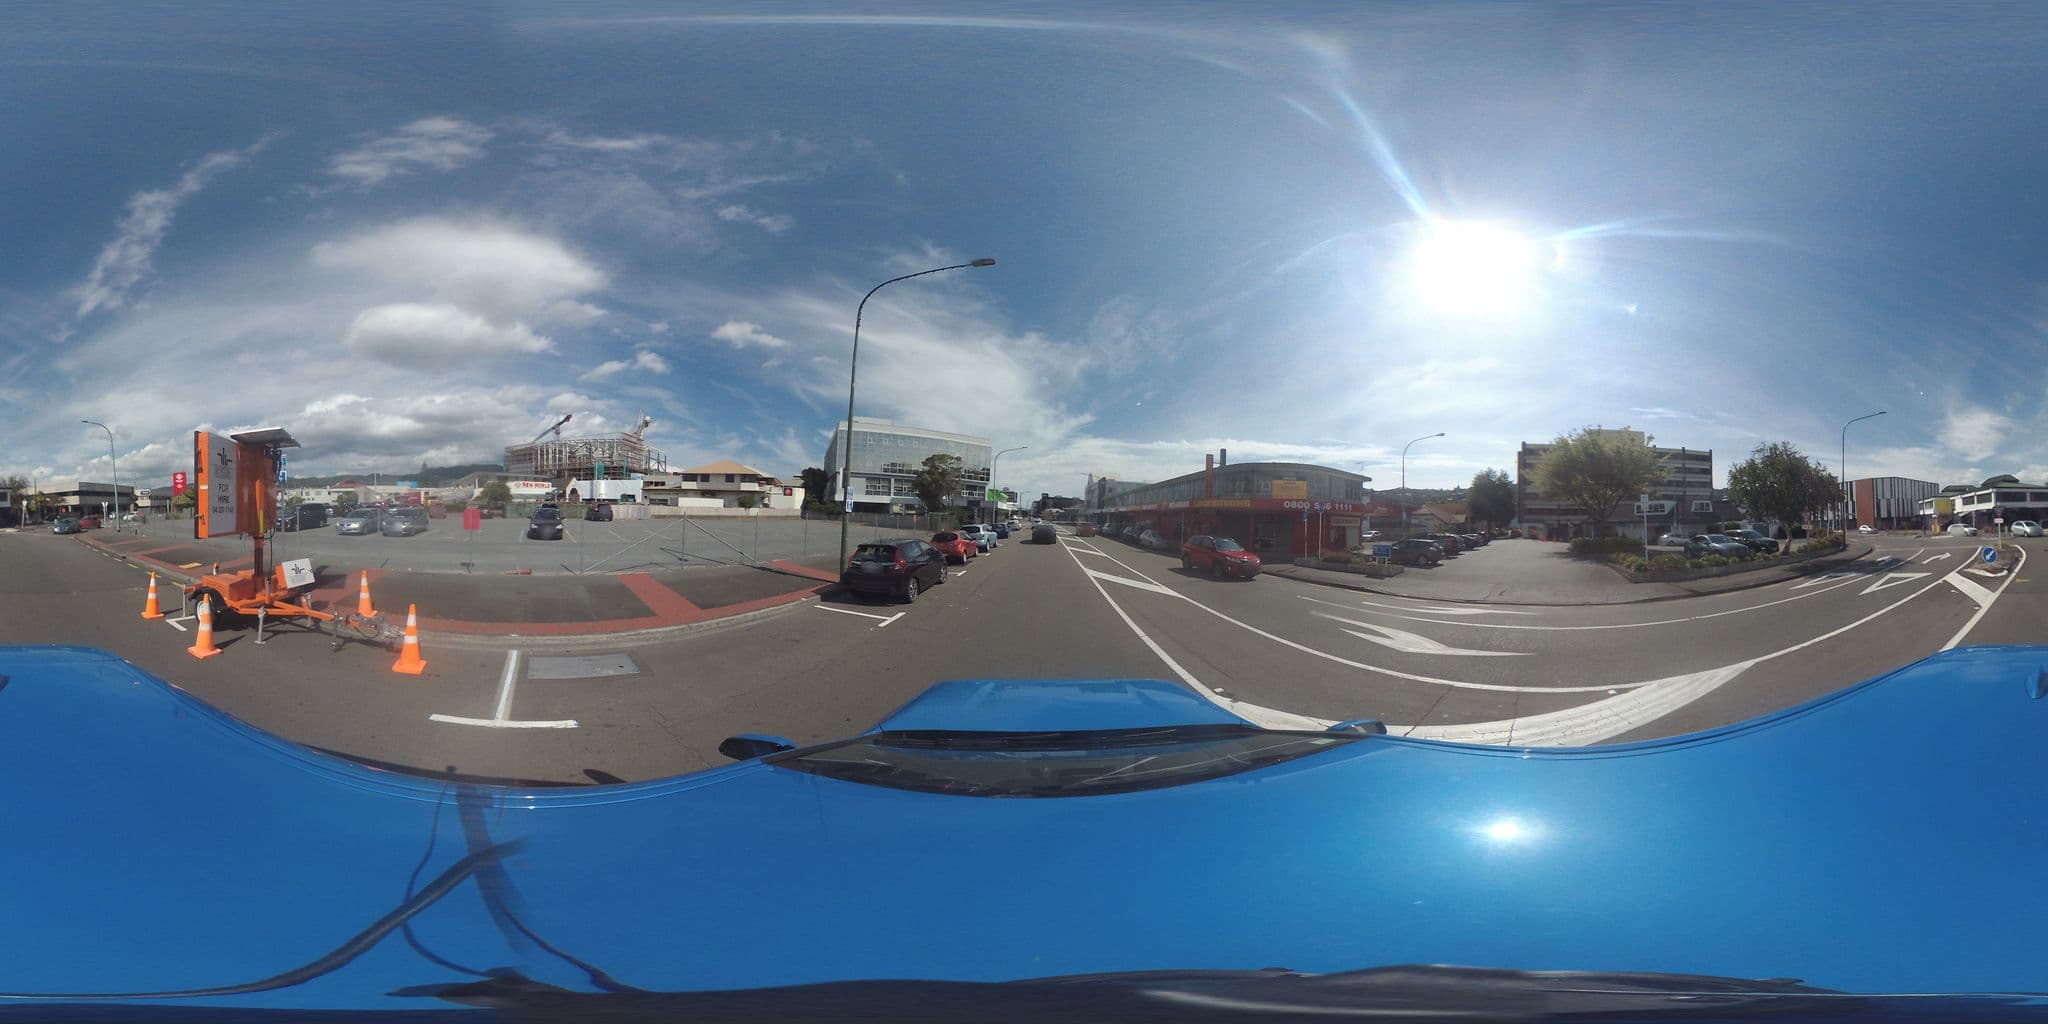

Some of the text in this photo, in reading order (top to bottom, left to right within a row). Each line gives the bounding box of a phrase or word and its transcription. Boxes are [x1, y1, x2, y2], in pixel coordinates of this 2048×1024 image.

[218, 483, 229, 492] FOR
[218, 495, 230, 503] HIRE
[1284, 501, 1310, 509] 0800
[1314, 502, 1331, 510] 56
